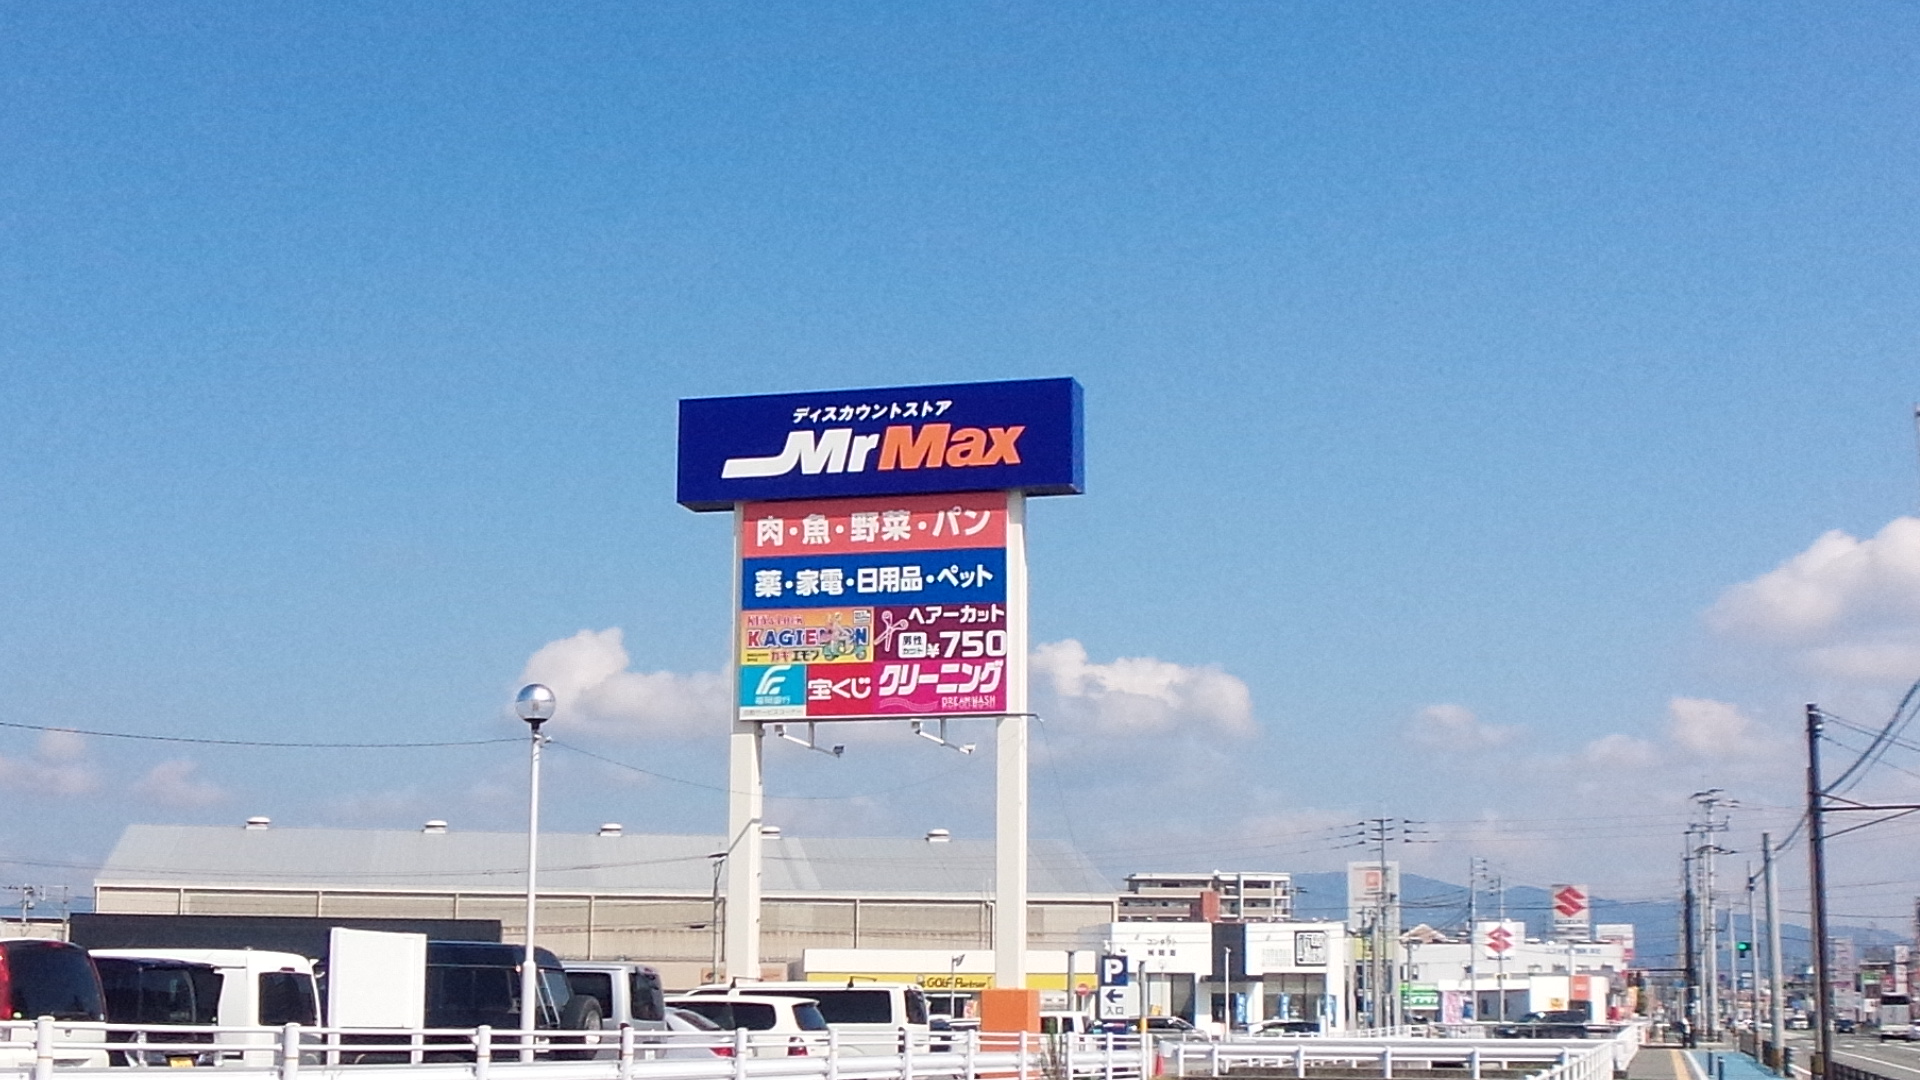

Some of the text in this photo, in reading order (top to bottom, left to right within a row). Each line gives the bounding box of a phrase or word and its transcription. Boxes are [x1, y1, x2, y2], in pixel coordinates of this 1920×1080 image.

[793, 400, 952, 423] ディスカウントストア
[756, 506, 991, 547] 肉・魚・野菜・パン
[755, 564, 993, 598] 薬・家電・日用品・ペット
[908, 603, 1004, 624] ヘアーカット
[903, 635, 922, 645] 男性
[927, 630, 1007, 658] ¥750
[808, 679, 871, 700] 宝くじ
[879, 660, 1004, 696] クリーニング
[927, 977, 952, 987] GOLF
[1105, 959, 1123, 983] P
[1105, 1006, 1123, 1015] 入口
